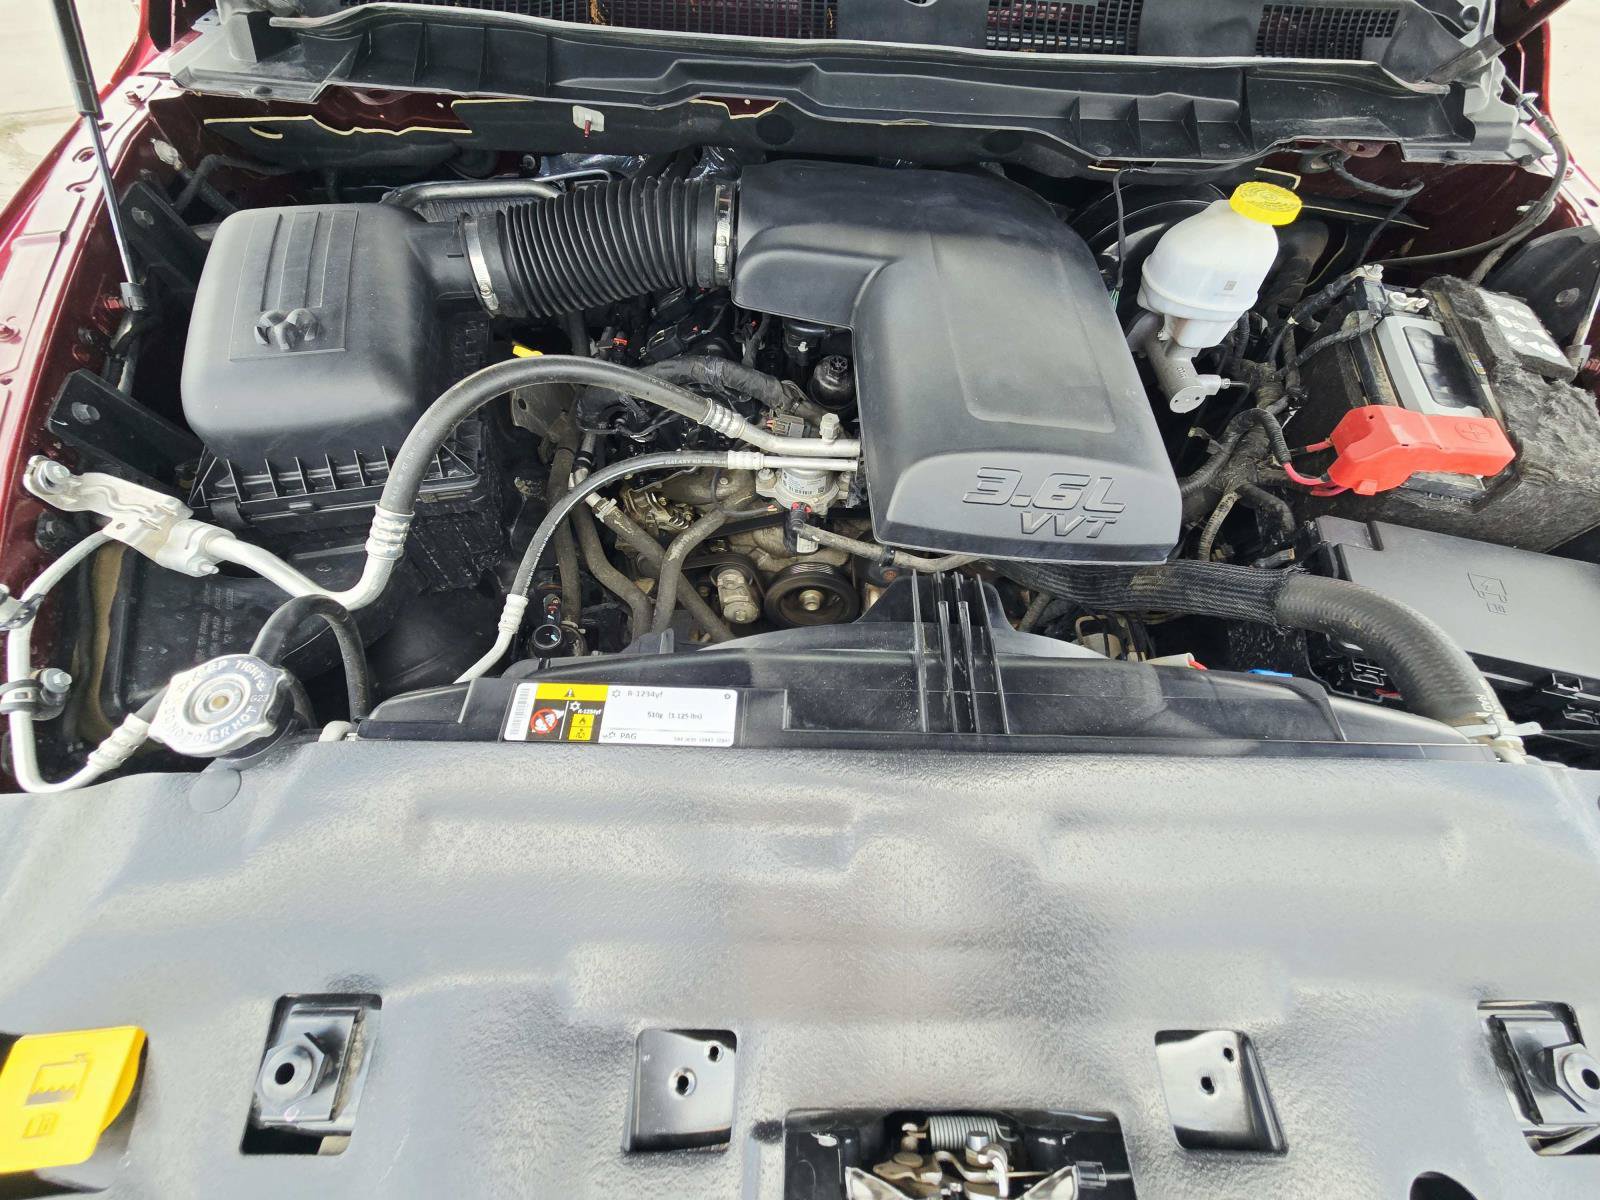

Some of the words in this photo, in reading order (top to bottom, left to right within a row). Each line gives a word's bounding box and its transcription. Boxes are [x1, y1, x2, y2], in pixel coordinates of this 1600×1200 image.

[962, 466, 1127, 514] 3.6L
[1020, 510, 1118, 539] VVT
[235, 659, 266, 681] TIGHT
[620, 732, 637, 741] PAG
